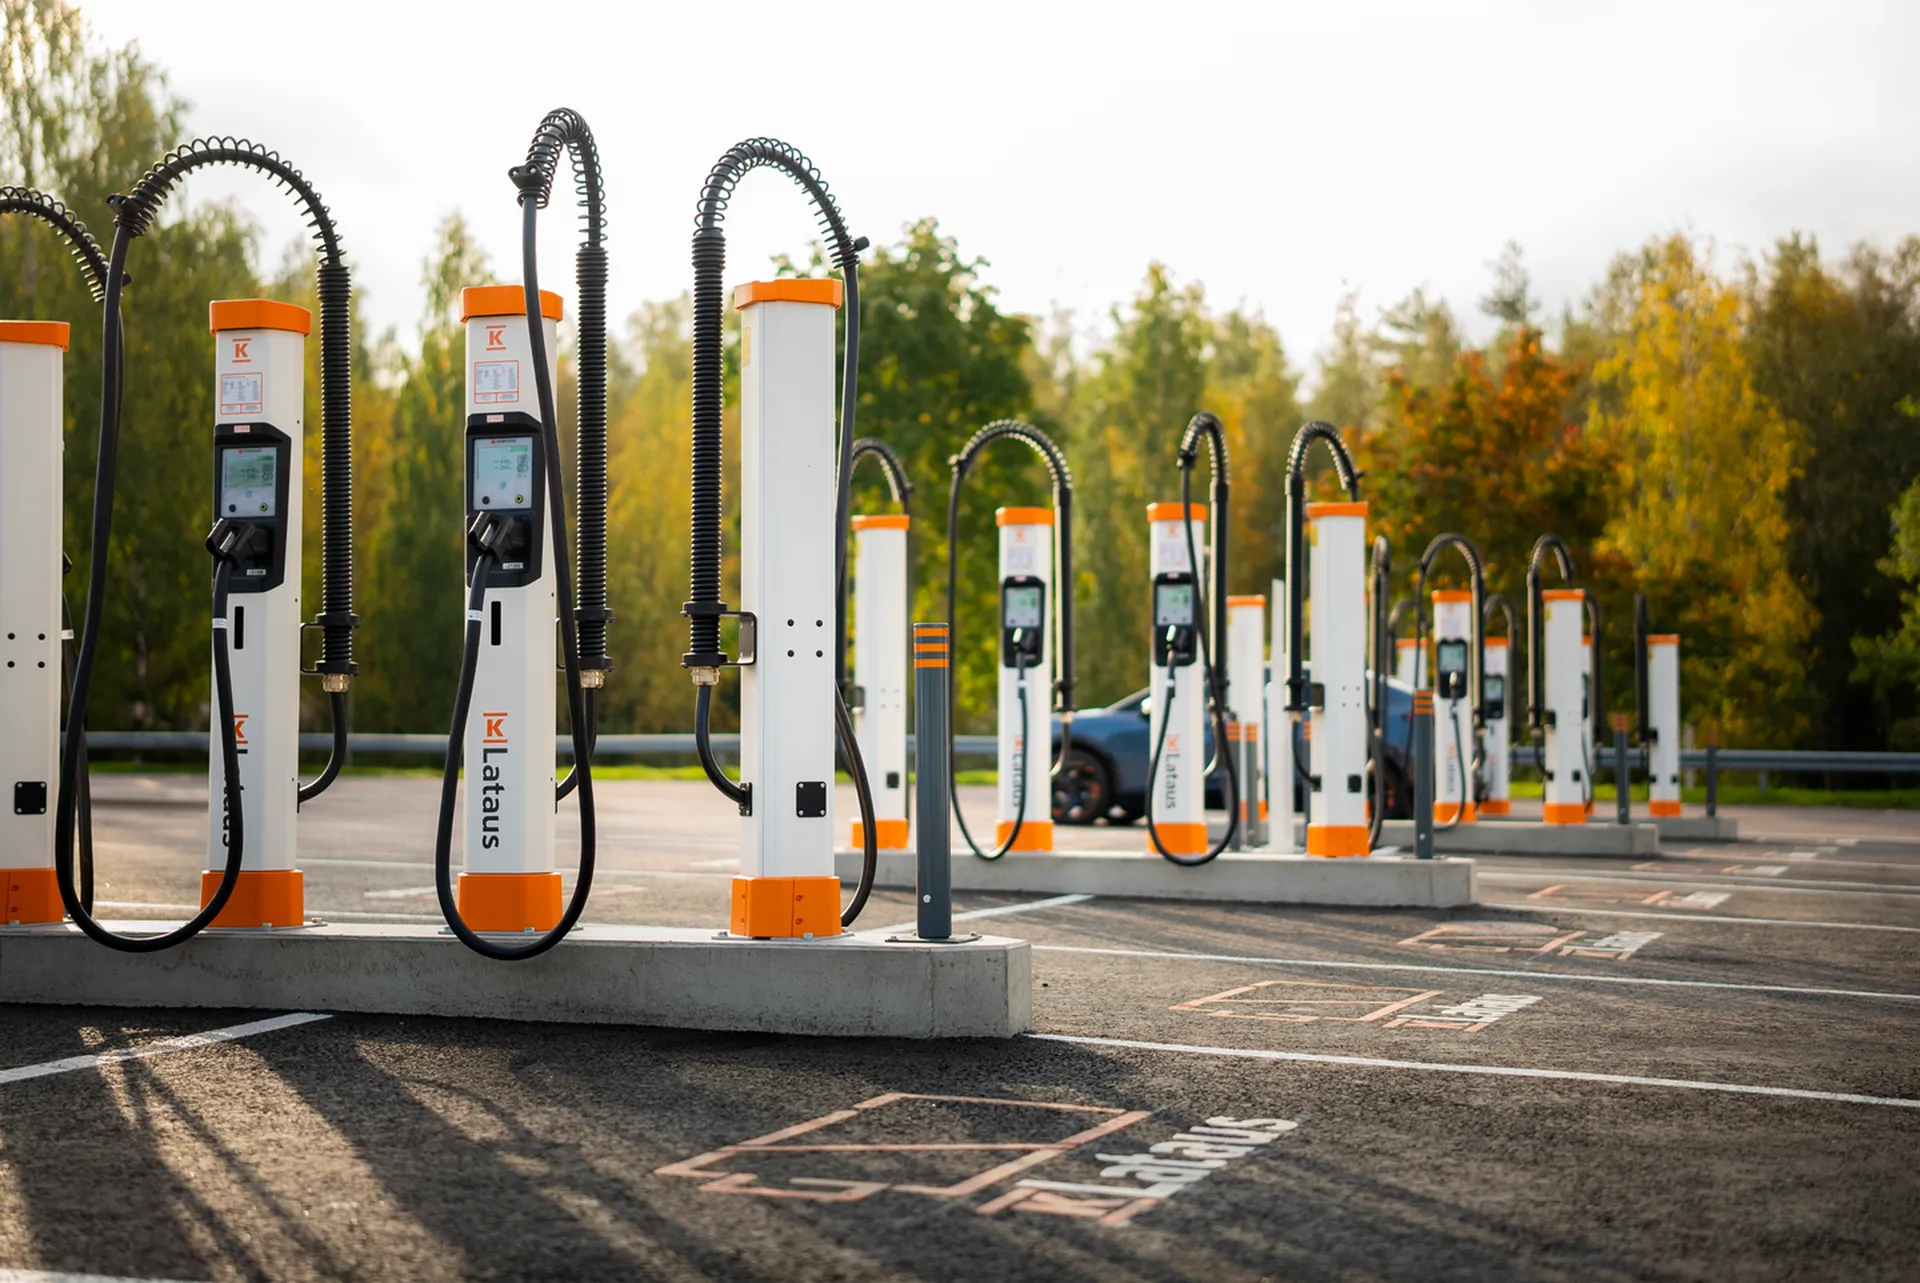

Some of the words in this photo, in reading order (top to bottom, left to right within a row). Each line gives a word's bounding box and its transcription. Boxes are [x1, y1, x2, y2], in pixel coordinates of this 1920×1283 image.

[487, 328, 505, 347] K
[233, 342, 250, 360] K
[485, 717, 505, 738] K
[482, 748, 508, 849] Lataus
[1014, 1115, 1299, 1199] Lataus
